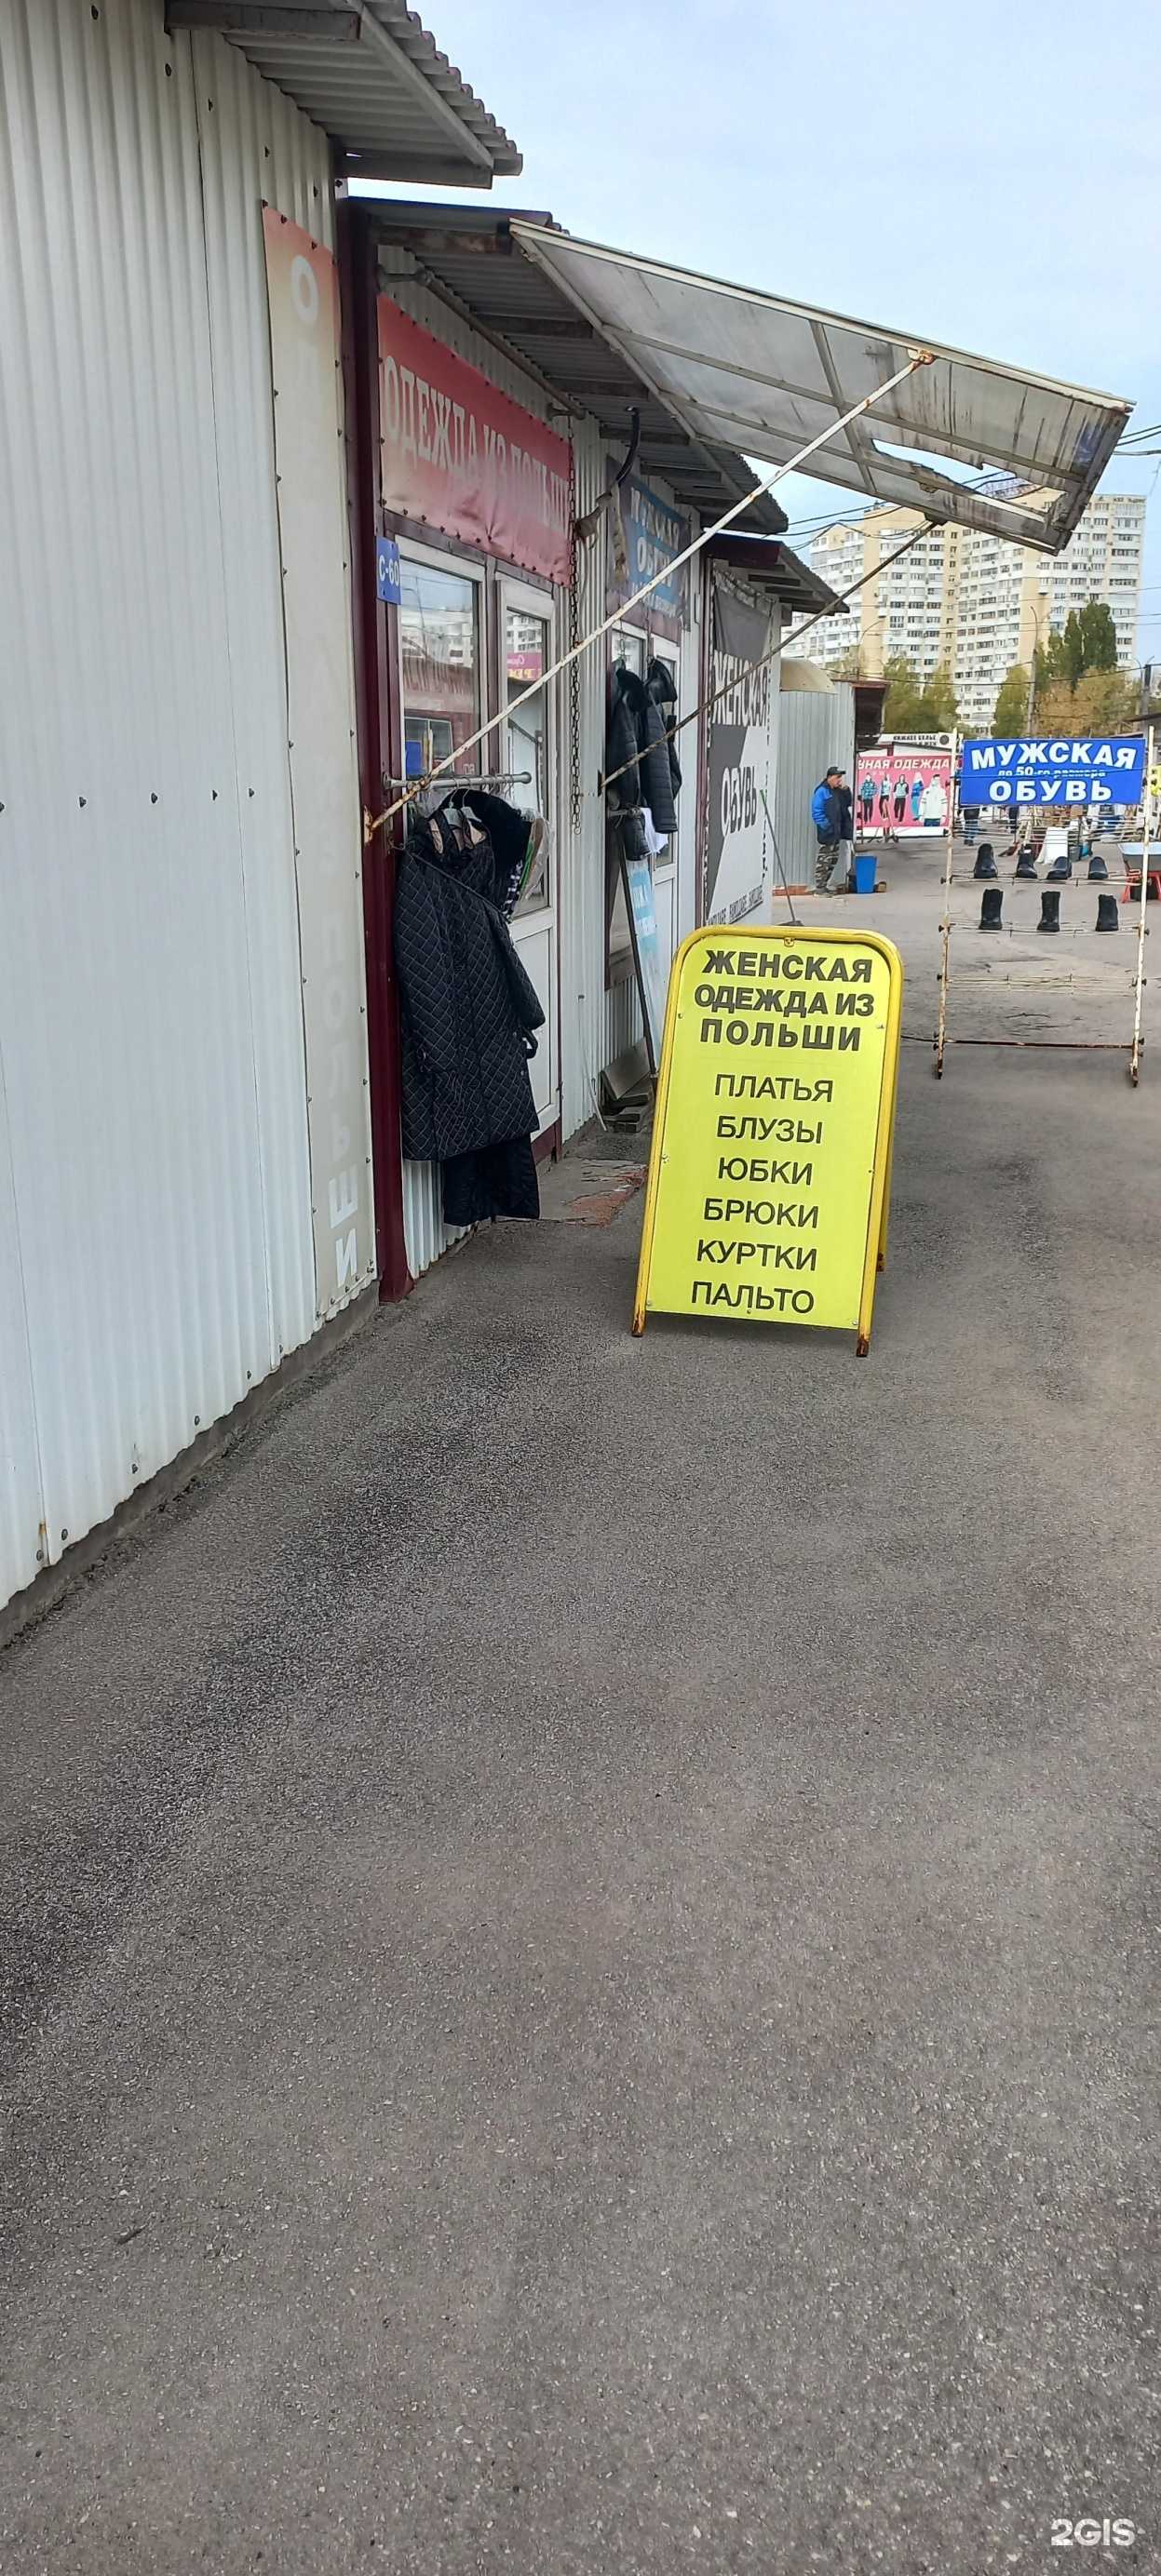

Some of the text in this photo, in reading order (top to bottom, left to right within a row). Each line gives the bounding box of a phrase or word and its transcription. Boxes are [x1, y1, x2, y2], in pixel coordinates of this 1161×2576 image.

[383, 356, 478, 476] ОДЕЖДА
[713, 651, 768, 727] ЖЕНСКАЯ
[894, 758, 950, 771] ОДЕЖДА
[970, 741, 1137, 771] МУЖСКАЯ
[722, 767, 757, 837] ОБУВЬ
[989, 780, 1113, 802] ОБУВЬ
[701, 948, 872, 984] ЖЕНСКАЯ
[694, 984, 874, 1017] ОДЕЖДА ИЗ
[700, 1019, 861, 1051] ПОЛЬШИ
[714, 1073, 833, 1103] ПЛАТЬЯ
[716, 1116, 822, 1145] БЛУЗЫ
[718, 1157, 812, 1187] ЮБКИ
[703, 1198, 818, 1228] БРЮКИ
[696, 1240, 817, 1271] КУРТКИ
[691, 1281, 815, 1314] ПАЛЬТО
